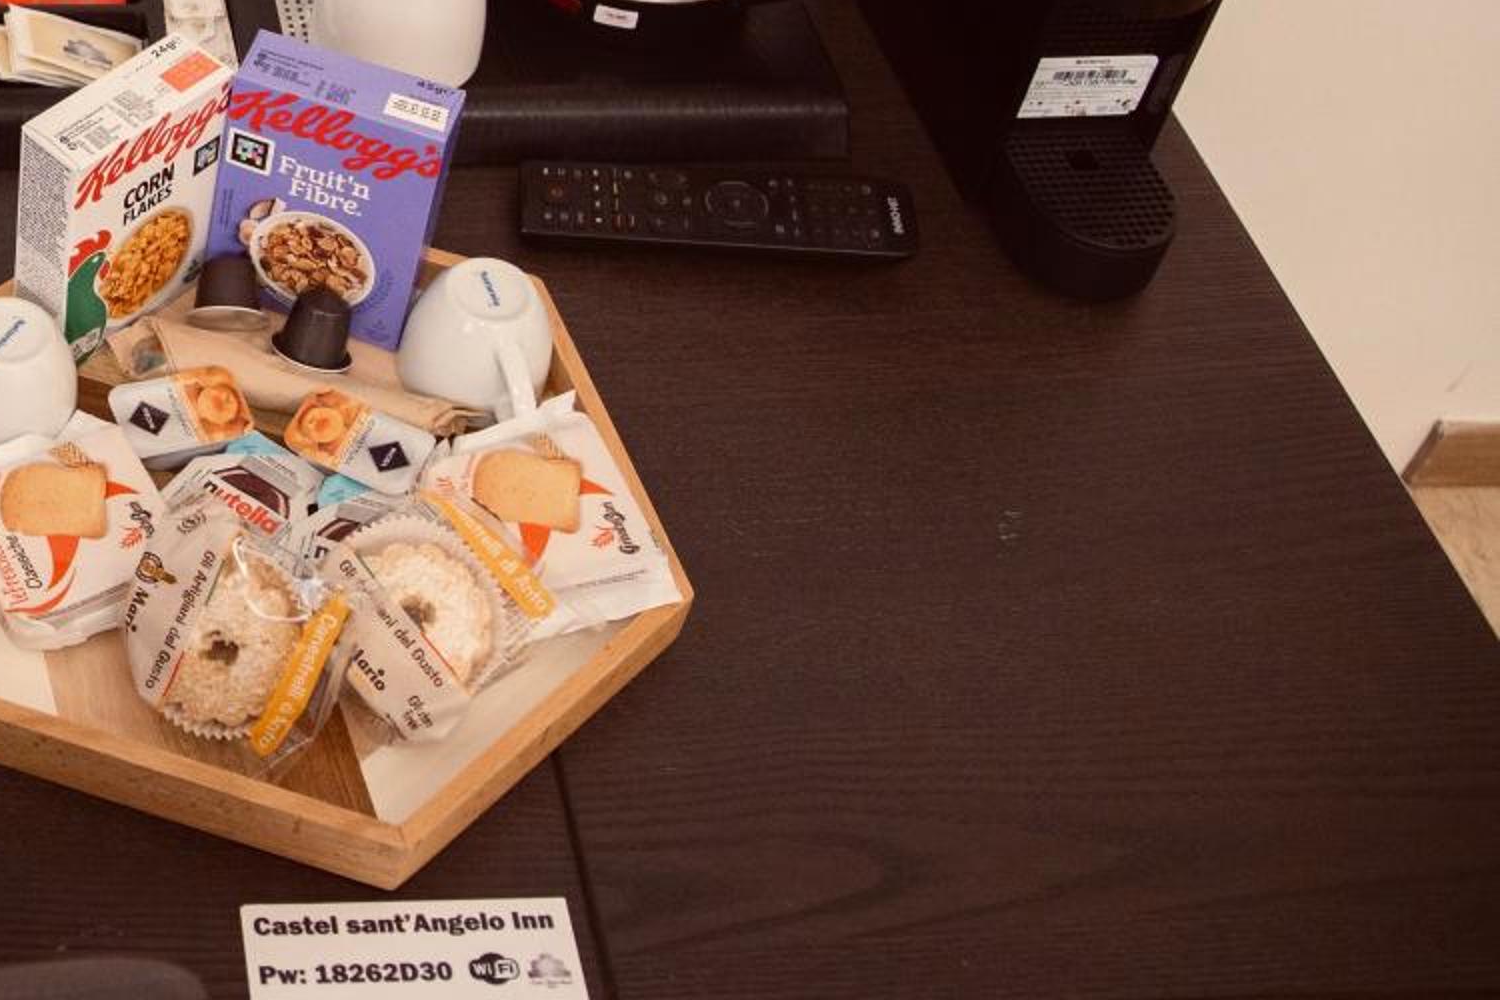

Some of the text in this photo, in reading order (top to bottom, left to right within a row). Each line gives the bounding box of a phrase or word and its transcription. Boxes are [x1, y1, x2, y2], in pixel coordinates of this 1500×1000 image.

[73, 83, 233, 210] Kellogg's
[228, 89, 442, 180] Kellogg's
[123, 164, 175, 208] CORN
[123, 184, 173, 226] FLAKES
[203, 479, 282, 536] nutella
[125, 586, 150, 633] Mari
[174, 569, 208, 626] Artigiani
[165, 625, 181, 651] del
[394, 628, 445, 689] del Gusto
[145, 650, 171, 690] Gusto
[350, 647, 387, 692] ario
[252, 910, 555, 937] Castel sant'Angelo Inn
[258, 964, 307, 985] Pw:
[314, 961, 454, 984] 18262D30
